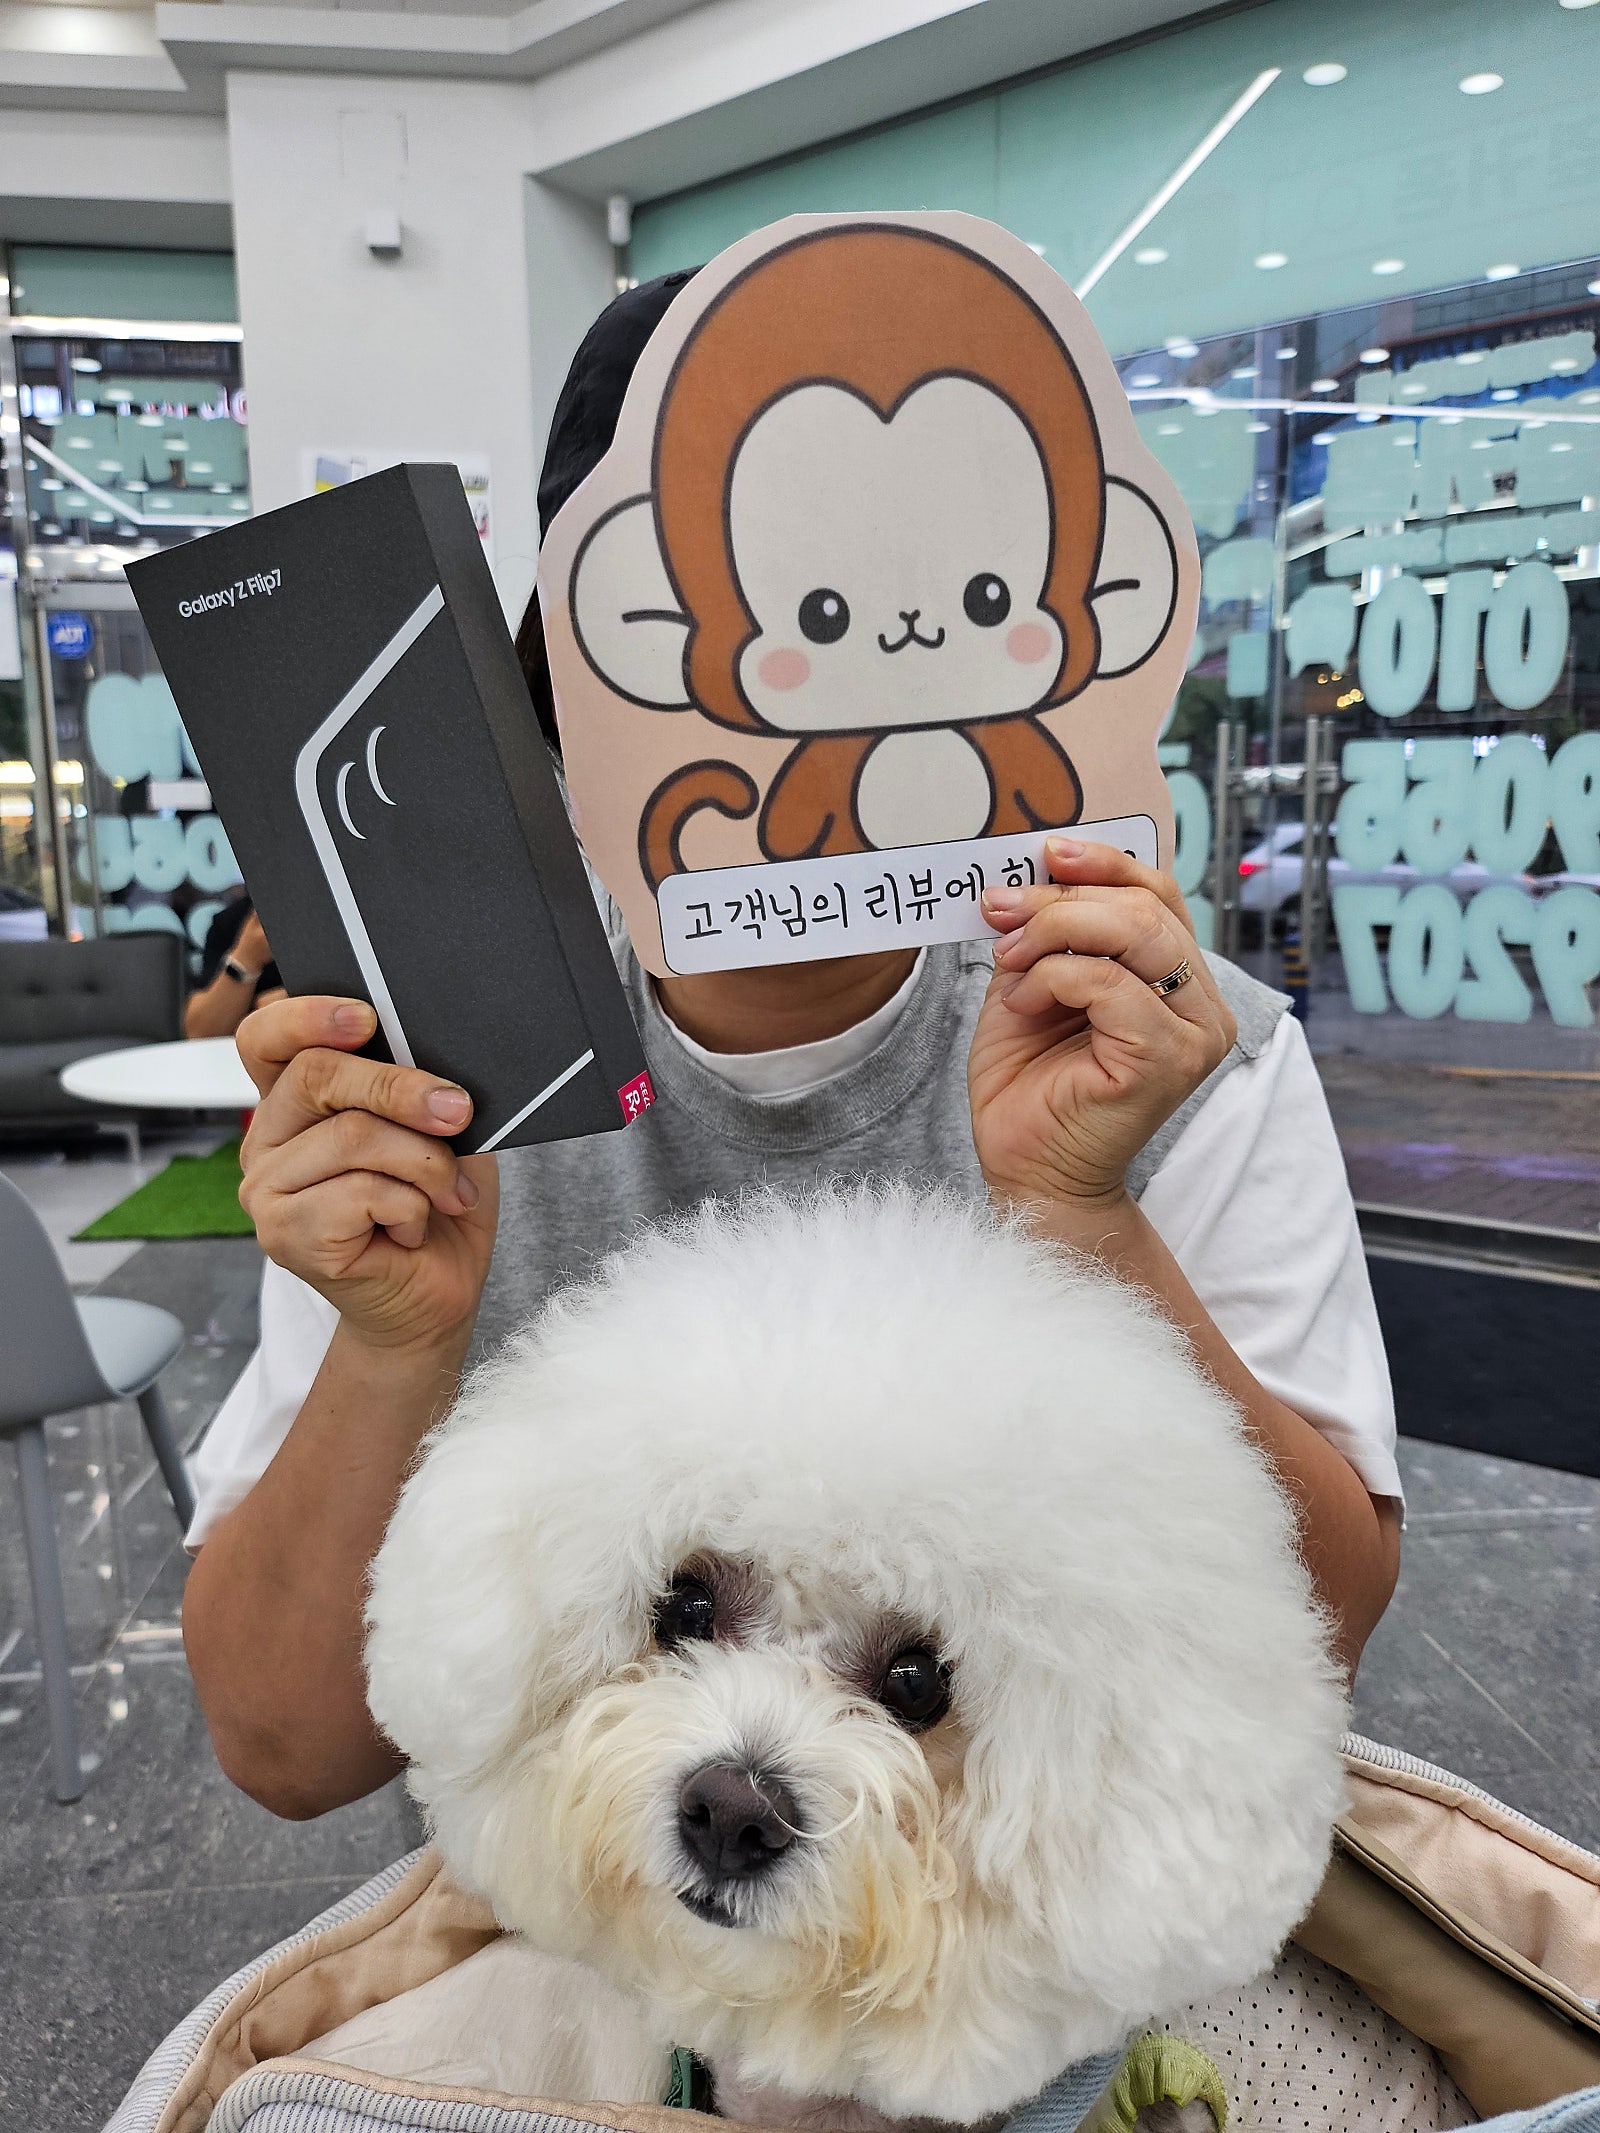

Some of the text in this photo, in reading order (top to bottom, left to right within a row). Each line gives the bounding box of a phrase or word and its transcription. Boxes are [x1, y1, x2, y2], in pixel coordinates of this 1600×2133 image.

[178, 568, 282, 618] Galaxy Z Flip7
[685, 882, 849, 940] 고객님의
[863, 863, 985, 925] 리뷰에
